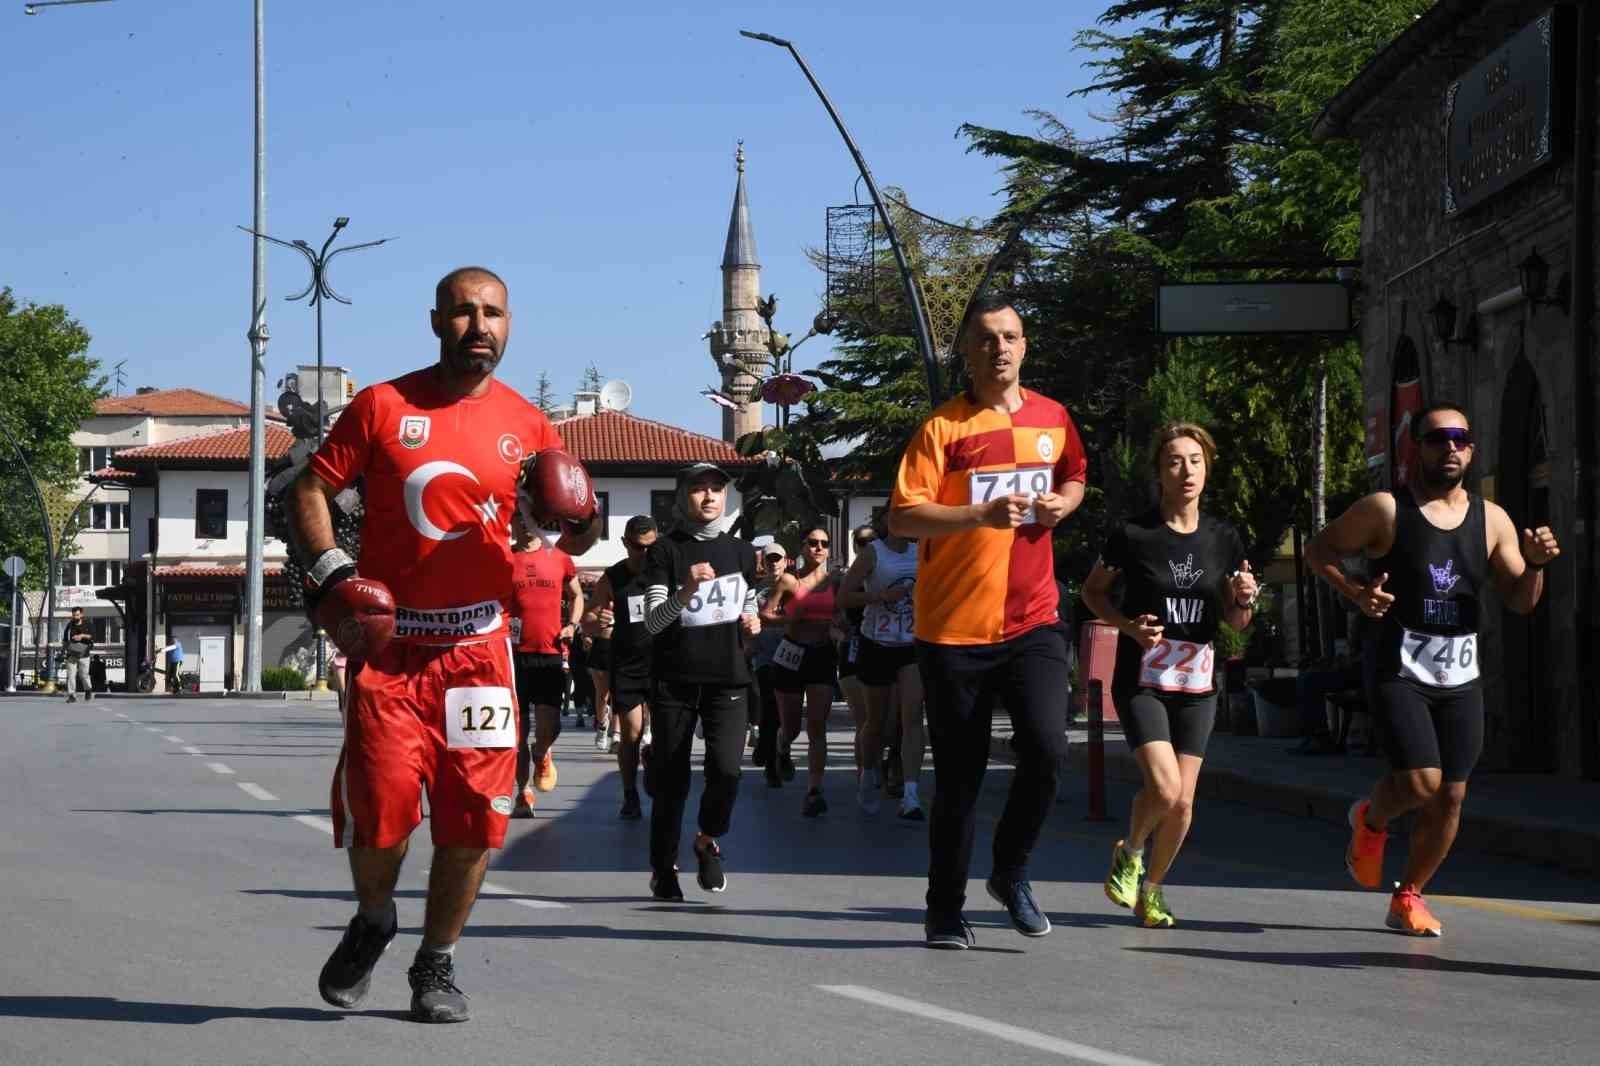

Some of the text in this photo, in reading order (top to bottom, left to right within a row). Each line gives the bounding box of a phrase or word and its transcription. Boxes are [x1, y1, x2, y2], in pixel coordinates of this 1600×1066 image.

[1150, 639, 1211, 673] 228
[1409, 633, 1473, 669] 746
[462, 705, 511, 731] 127
